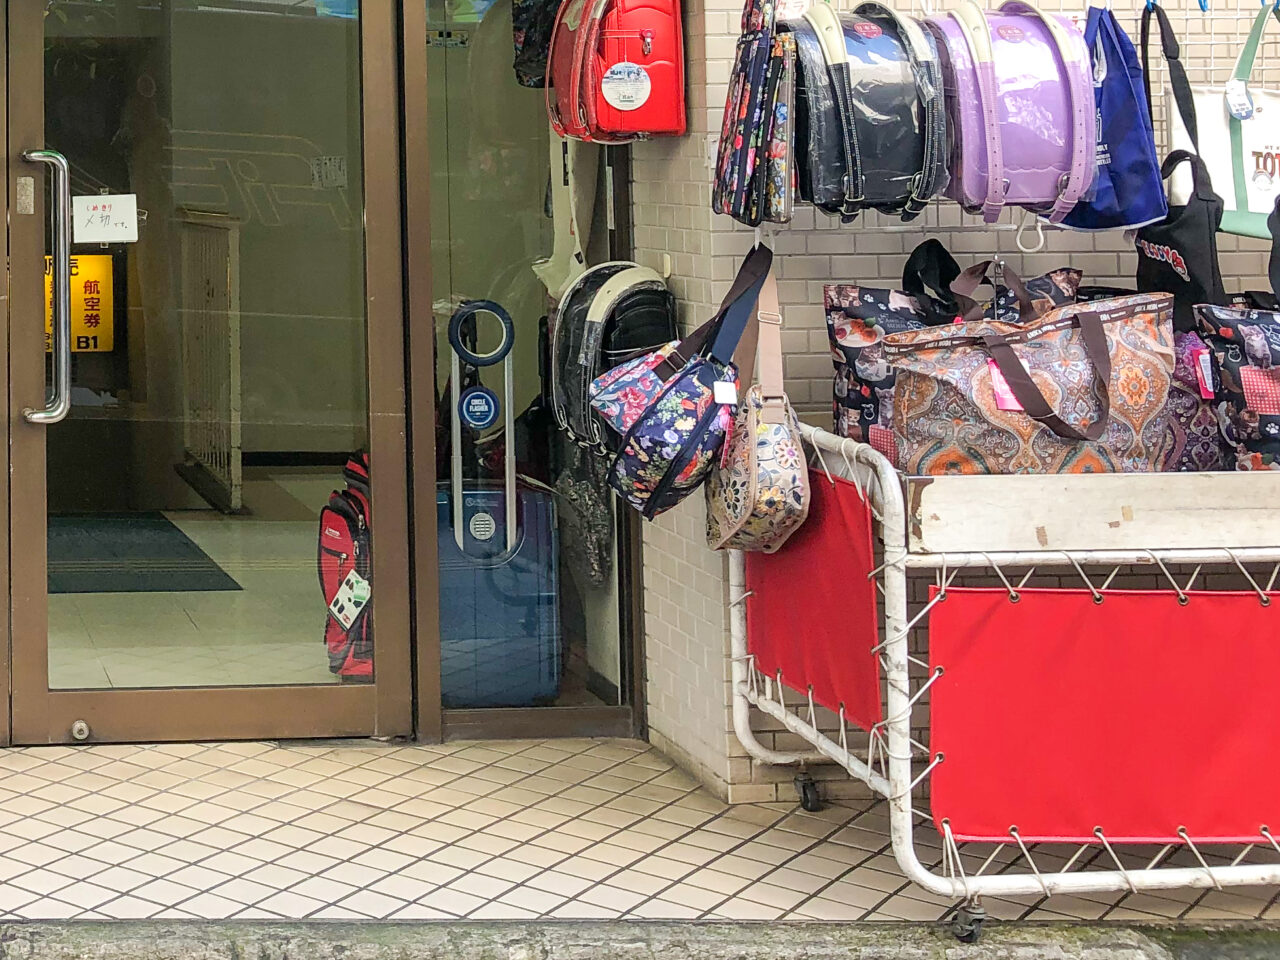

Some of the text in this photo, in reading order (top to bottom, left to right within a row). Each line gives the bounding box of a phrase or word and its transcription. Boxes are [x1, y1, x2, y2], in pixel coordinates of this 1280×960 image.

[83, 280, 101, 328] 航空券
[76, 335, 98, 350] B1
